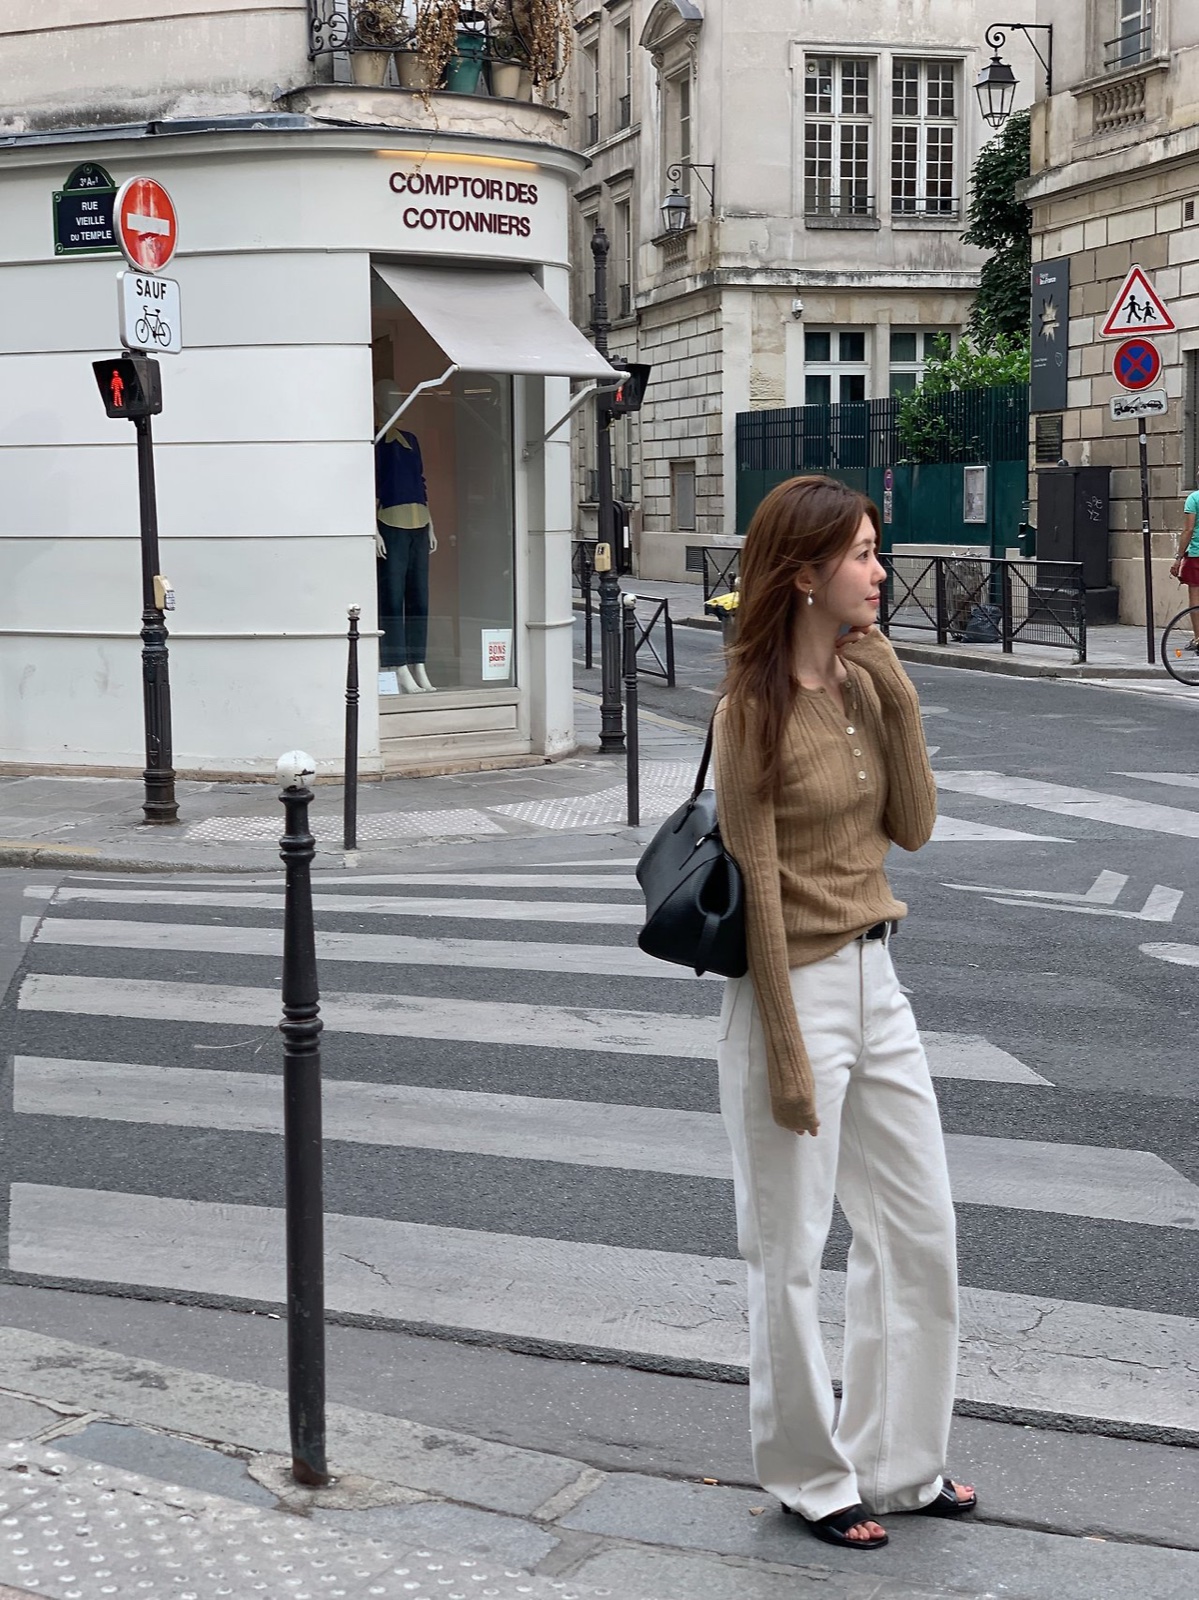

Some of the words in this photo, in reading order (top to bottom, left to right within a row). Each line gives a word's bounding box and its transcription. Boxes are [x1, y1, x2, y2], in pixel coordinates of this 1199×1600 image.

[390, 172, 503, 201] COMPTOIR
[506, 182, 538, 205] DES
[81, 201, 98, 210] RUE
[76, 216, 105, 226] VIEILLE
[403, 207, 531, 237] COTONNIERS
[81, 231, 112, 240] TEMPLE
[136, 279, 167, 300] SAUF
[489, 645, 506, 654] BONS
